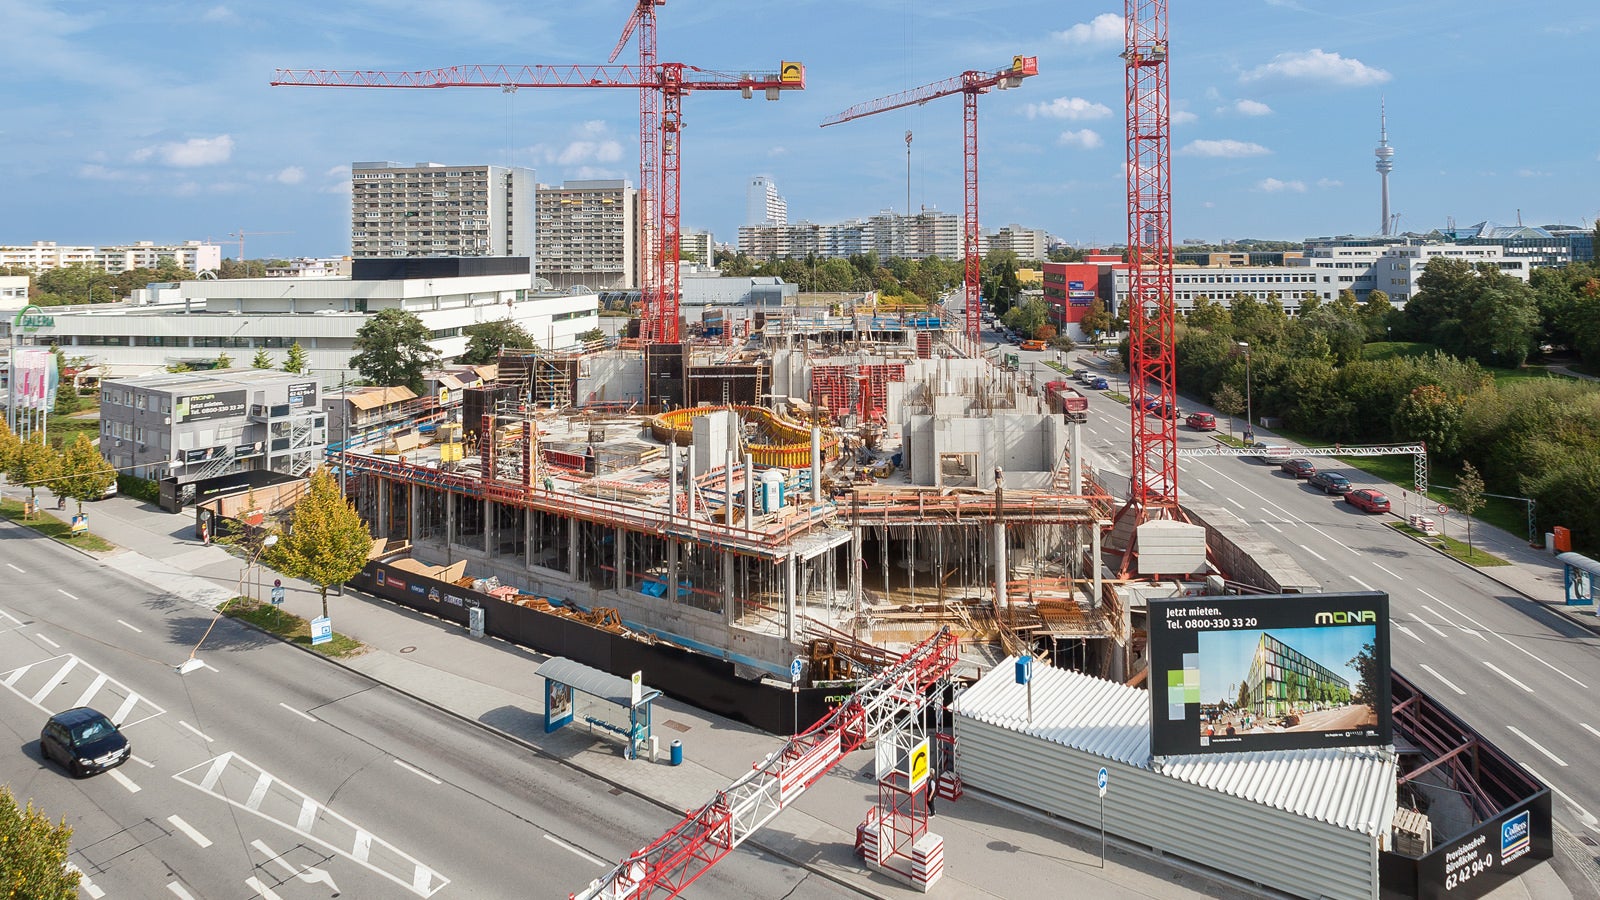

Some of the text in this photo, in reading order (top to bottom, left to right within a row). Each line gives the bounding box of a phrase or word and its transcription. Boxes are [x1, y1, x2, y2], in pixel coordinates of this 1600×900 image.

[1166, 606, 1222, 618] Jetzt mieten.
[1166, 617, 1258, 629] Tel. 0800-330 33 20
[1445, 853, 1493, 891] 62 42 94-0
